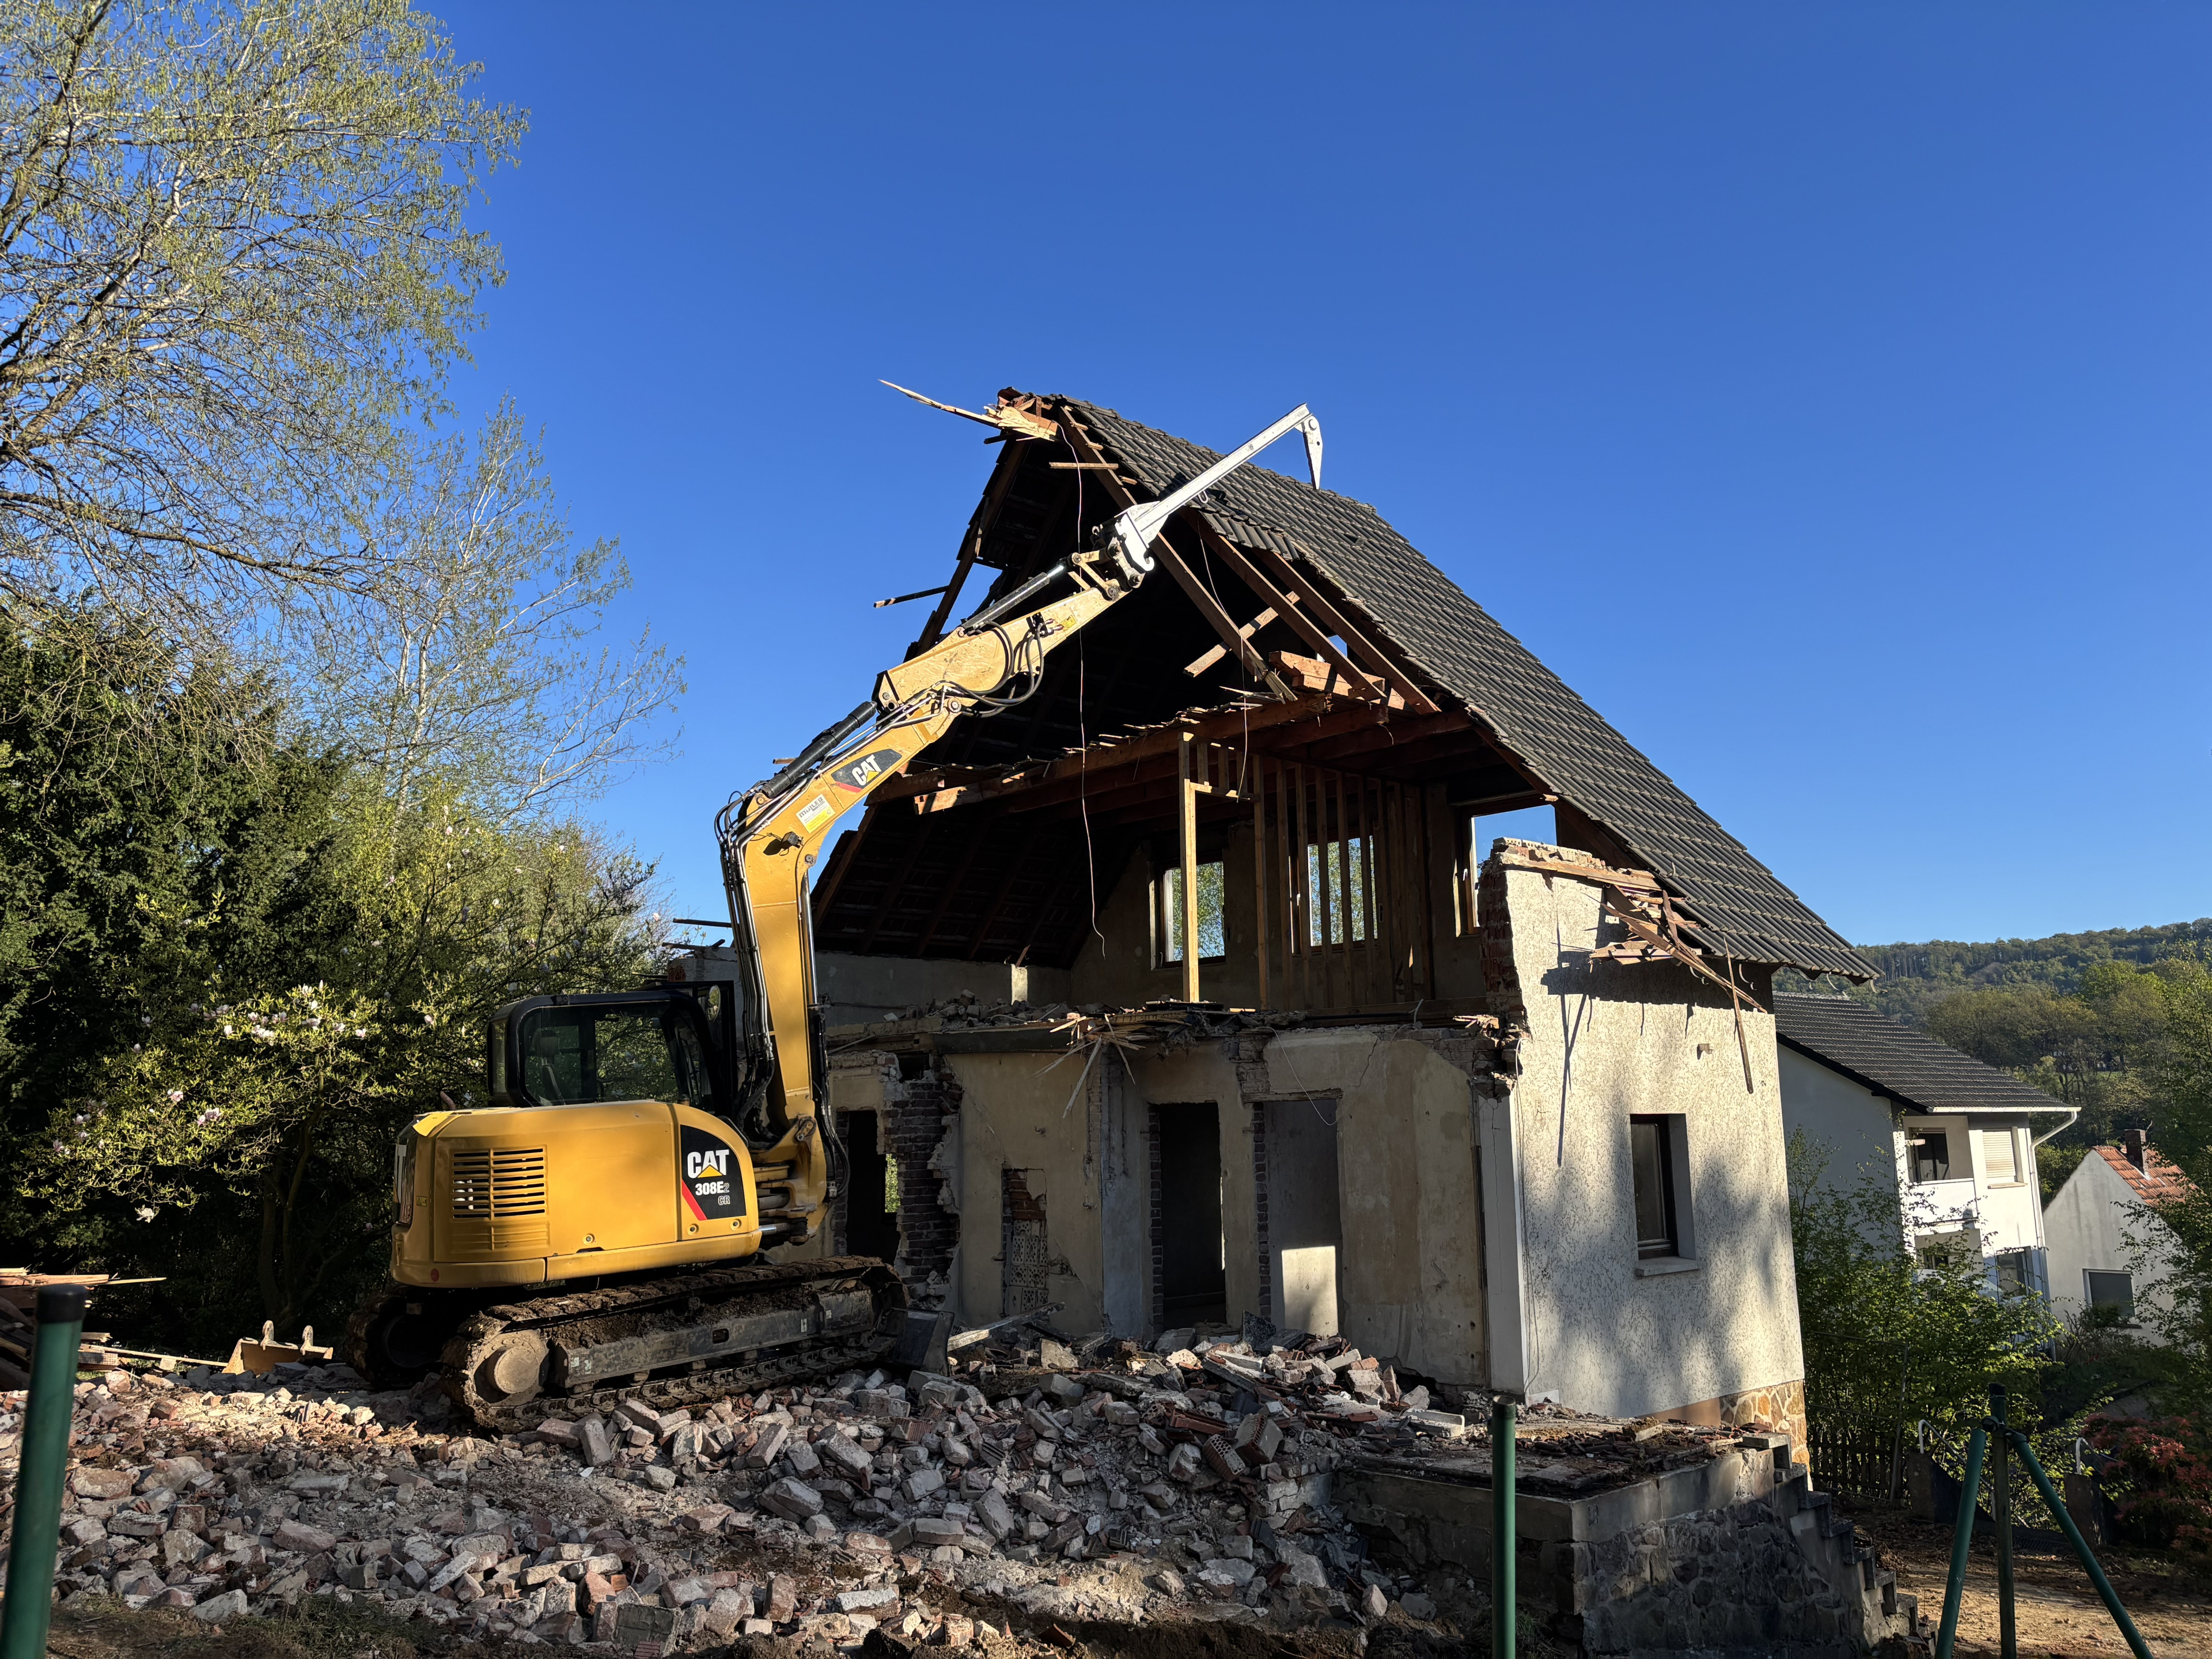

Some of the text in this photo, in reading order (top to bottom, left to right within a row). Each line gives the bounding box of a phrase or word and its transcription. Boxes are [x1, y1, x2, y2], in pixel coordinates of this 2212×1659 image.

[851, 754, 881, 786] CAT
[687, 1149, 729, 1179] CAT
[695, 1181, 729, 1195] 308E2
[718, 1195, 730, 1205] CR
